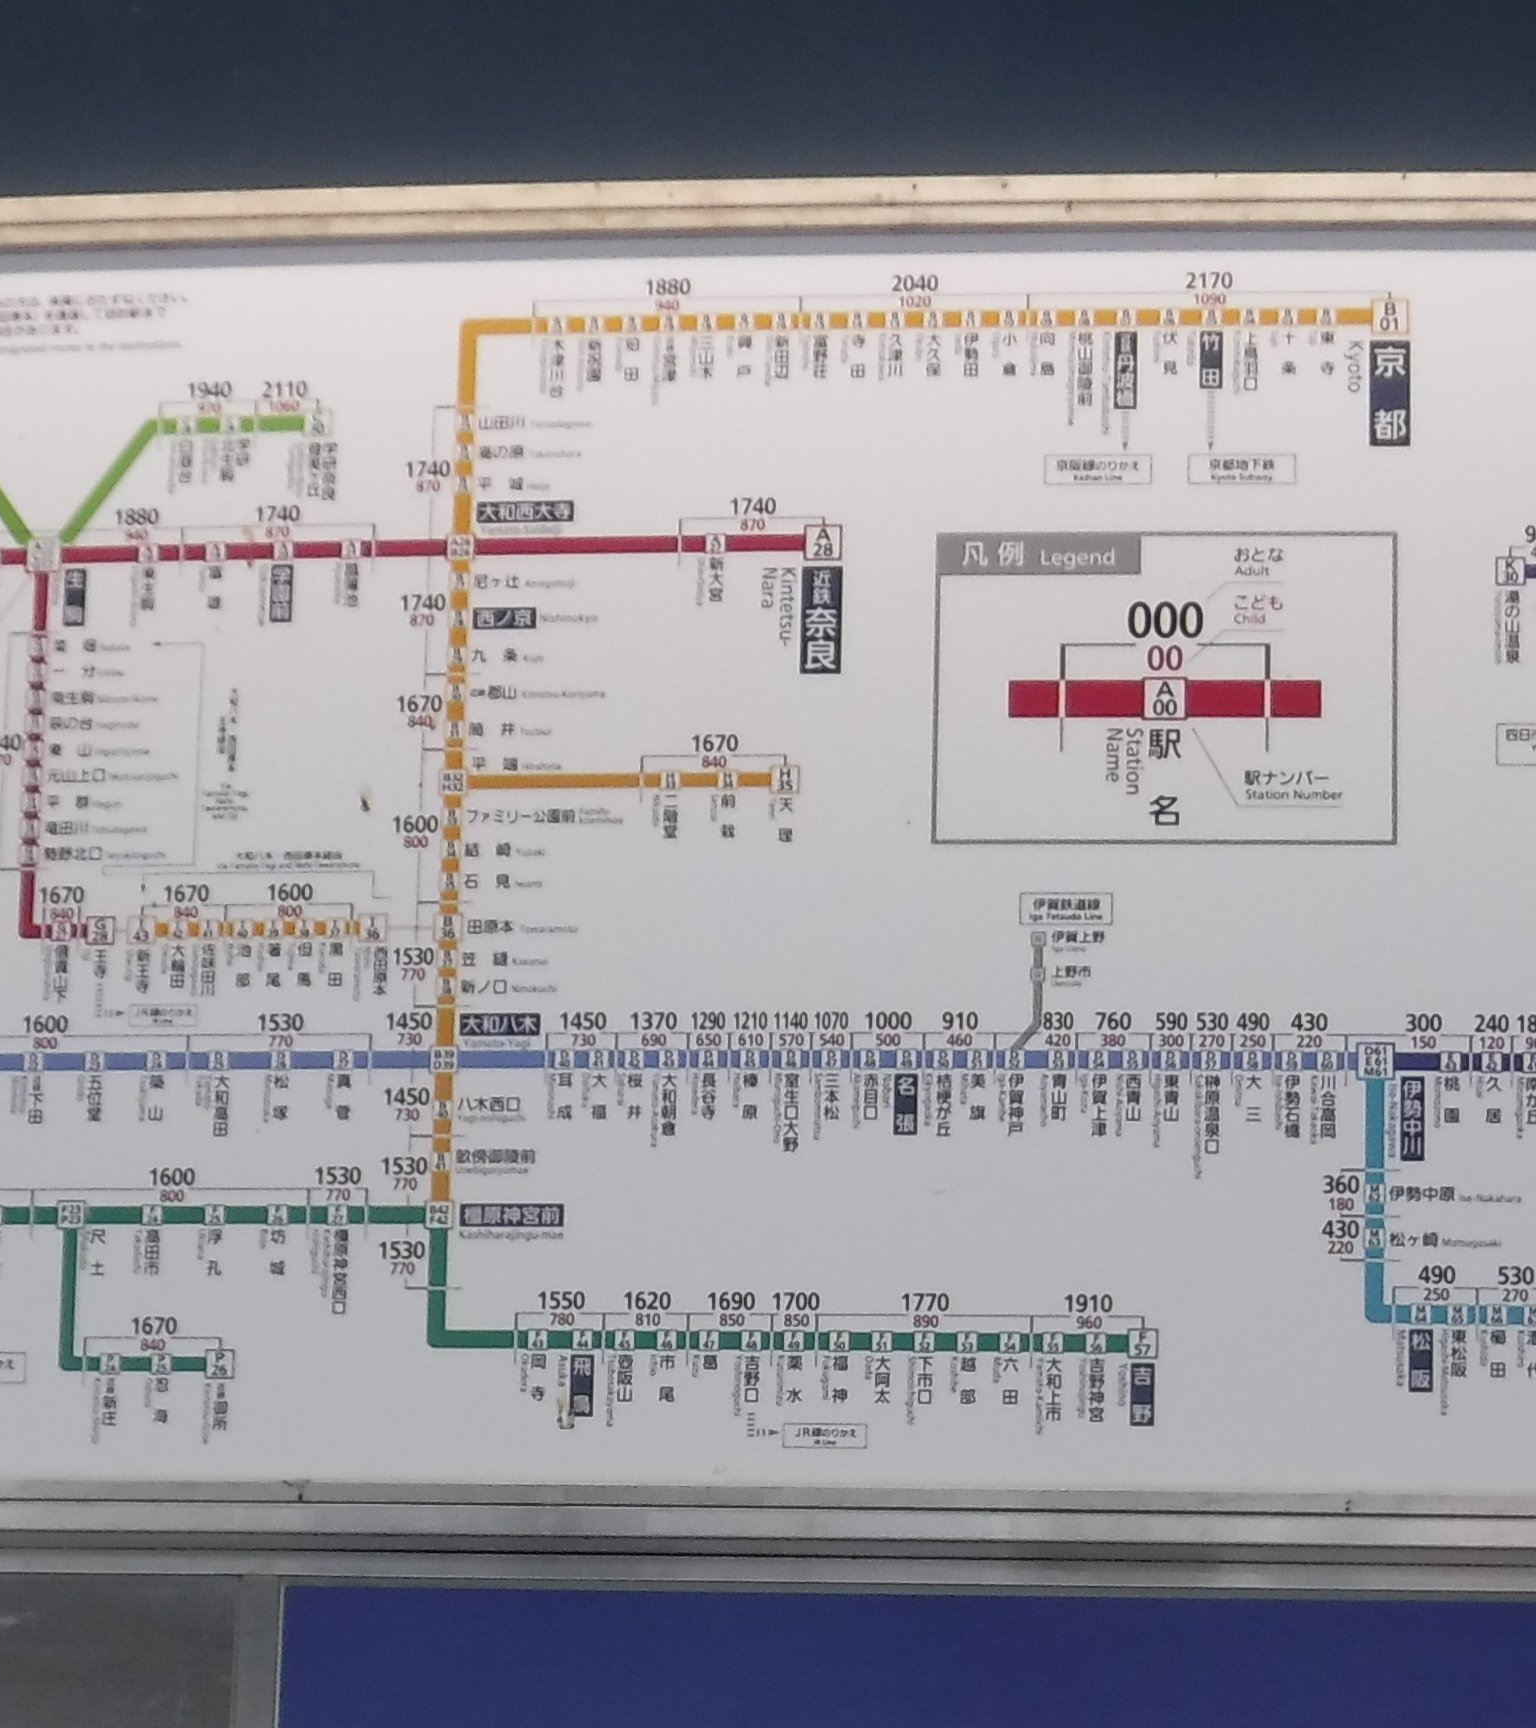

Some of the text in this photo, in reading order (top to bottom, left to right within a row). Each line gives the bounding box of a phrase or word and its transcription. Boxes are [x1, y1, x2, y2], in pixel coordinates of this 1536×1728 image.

[648, 278, 691, 295] 1880
[892, 275, 938, 292] 2040
[1186, 272, 1233, 289] 2170
[1344, 341, 1363, 393] Kyoto
[1373, 346, 1407, 441] 京都
[407, 460, 450, 477] 1740
[479, 503, 571, 520] 大和西大寺
[731, 498, 776, 515] 1740
[962, 542, 1116, 567] 凡例 Legend
[1234, 548, 1283, 562] おとな
[1235, 566, 1269, 576] Adult
[761, 568, 778, 609] Nara
[1234, 595, 1283, 611] こども
[476, 611, 532, 627] 西ノ京
[806, 570, 838, 670] 近鉄奈良
[1128, 602, 1203, 638] 000
[1234, 613, 1265, 624] Child
[1148, 645, 1183, 671] 00
[1157, 682, 1174, 698] A
[1153, 700, 1177, 717] 00
[692, 734, 738, 752] 1670
[1106, 728, 1123, 782] Name
[1126, 728, 1144, 795] Station
[1149, 729, 1181, 826] 駅名
[1245, 770, 1329, 786] 駅ナンバー
[1246, 789, 1342, 800] Station Number
[394, 815, 438, 833] 1600
[258, 1013, 304, 1031] 1530
[387, 1012, 432, 1030] 1450
[462, 1016, 538, 1035] 大和八木
[631, 1012, 677, 1030] 1370
[692, 1011, 725, 1030] 1290
[1291, 1013, 1328, 1031] 430
[1406, 1014, 1442, 1032] 300
[1475, 1014, 1509, 1033] 240
[458, 1097, 520, 1112] 八木西口
[1403, 1079, 1422, 1159] 伊勢中川
[1389, 1186, 1455, 1202] 伊勢中原
[538, 1291, 585, 1310] 1550
[624, 1291, 671, 1310] 1620
[708, 1292, 755, 1310] 1690
[773, 1292, 820, 1311] 1700
[902, 1293, 949, 1312] 1770
[1065, 1294, 1113, 1313] 1910
[1412, 1333, 1431, 1389] 松阪
[1134, 1366, 1152, 1423] 吉野
